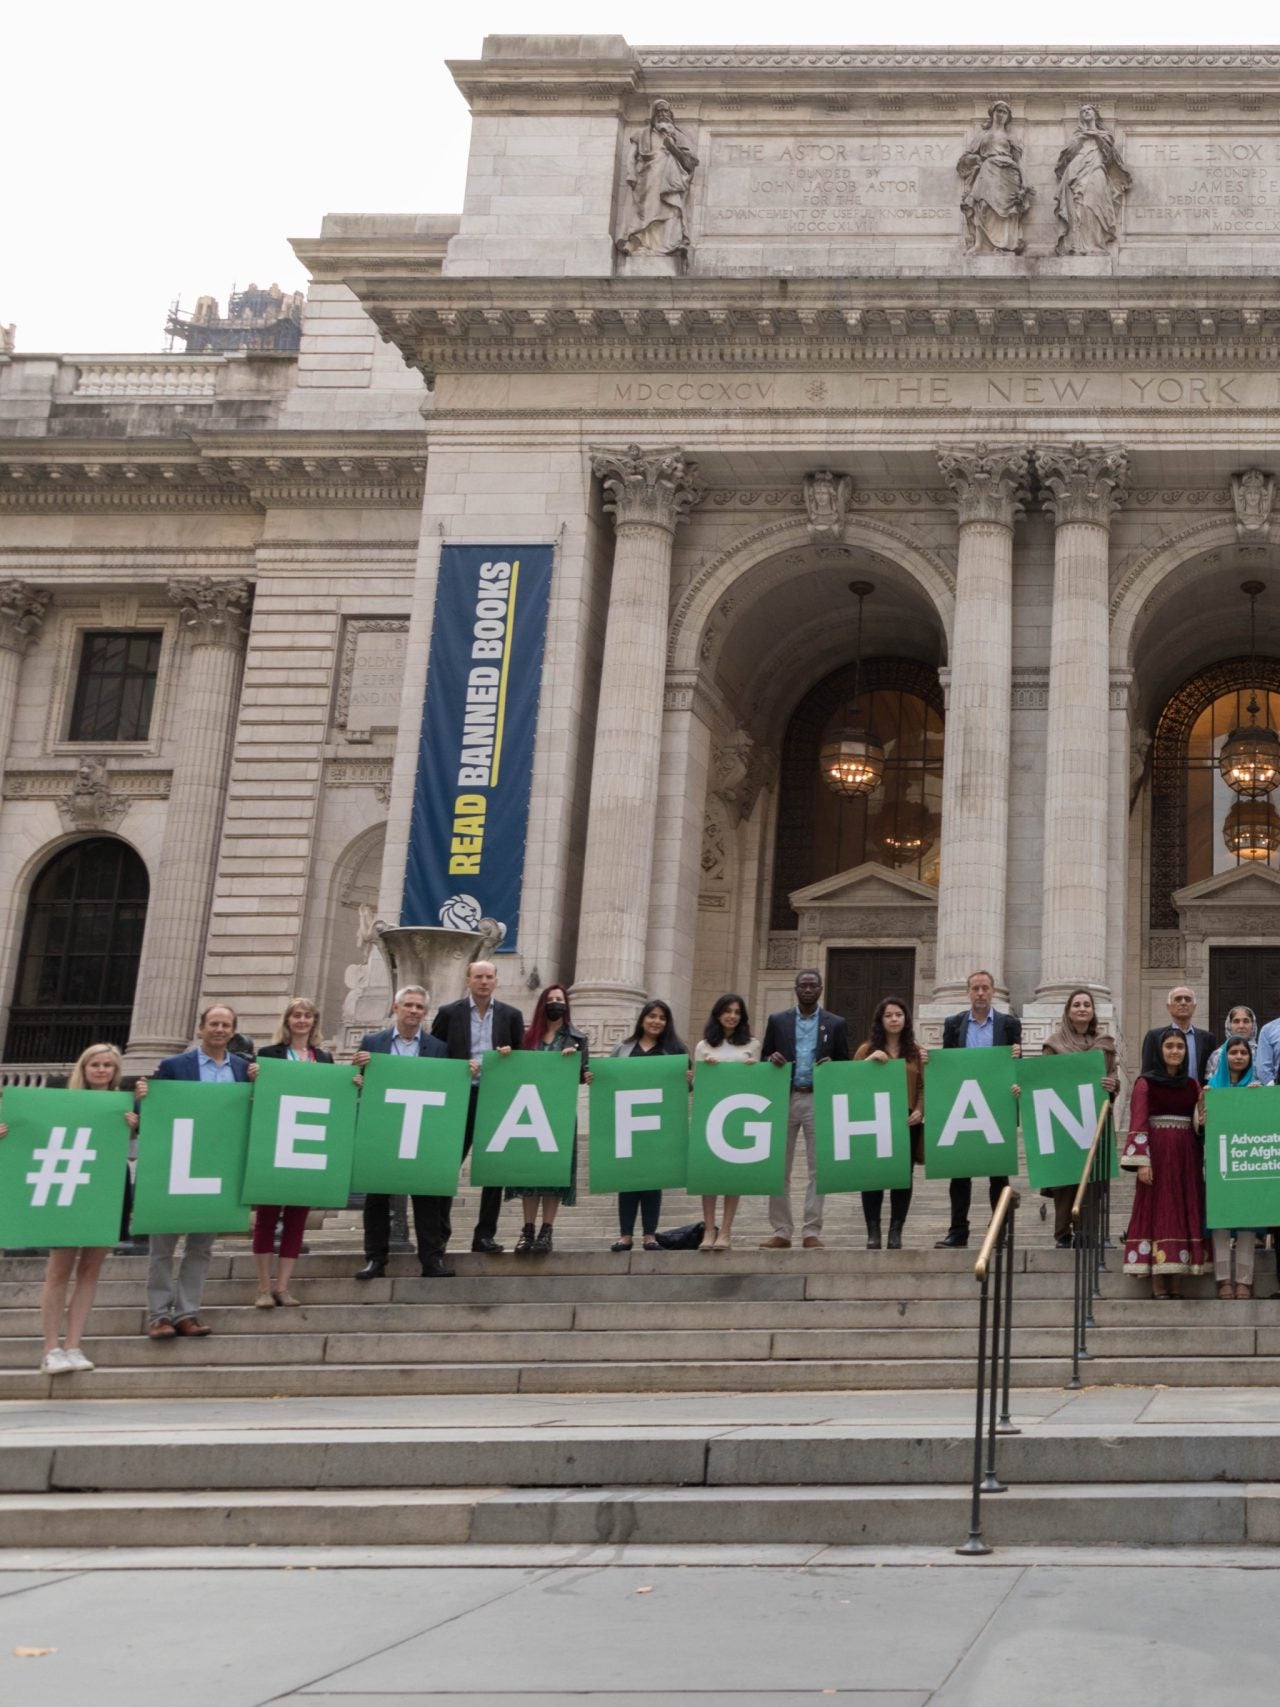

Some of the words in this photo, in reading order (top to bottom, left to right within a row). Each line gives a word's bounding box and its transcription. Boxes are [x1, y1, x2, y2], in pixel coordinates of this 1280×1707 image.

[723, 144, 764, 161] THE
[780, 144, 847, 161] ASTOR
[859, 144, 950, 161] LIBRARY
[1140, 144, 1180, 161] THE
[1192, 144, 1263, 161] LENOX
[789, 168, 851, 179] FOUNDED
[865, 168, 881, 178] BY
[1206, 168, 1268, 178] FOUNDED
[751, 181, 794, 193] JOHN
[802, 181, 857, 193] JACOB
[865, 181, 918, 193] ASTOR
[1188, 181, 1244, 193] JAMES
[803, 195, 830, 206] FOR
[836, 195, 862, 206] THE
[1168, 195, 1240, 206] DEDICATED
[1248, 195, 1266, 206] TO
[715, 208, 808, 220] ADVANCEMENT
[811, 208, 827, 219] OF
[832, 208, 875, 219] USEFUL
[879, 208, 953, 219] KNOWLEDGE
[1135, 208, 1219, 219] LITERATURE
[1230, 208, 1256, 219] AND
[613, 382, 774, 401] MDCCCXCV
[864, 377, 953, 404] THE
[986, 377, 1091, 403] NEW
[1129, 377, 1239, 403] YORK
[472, 561, 511, 659] BOOKS
[458, 666, 500, 787] BANNED
[449, 794, 487, 875] READ
[1230, 1147, 1248, 1158] for
